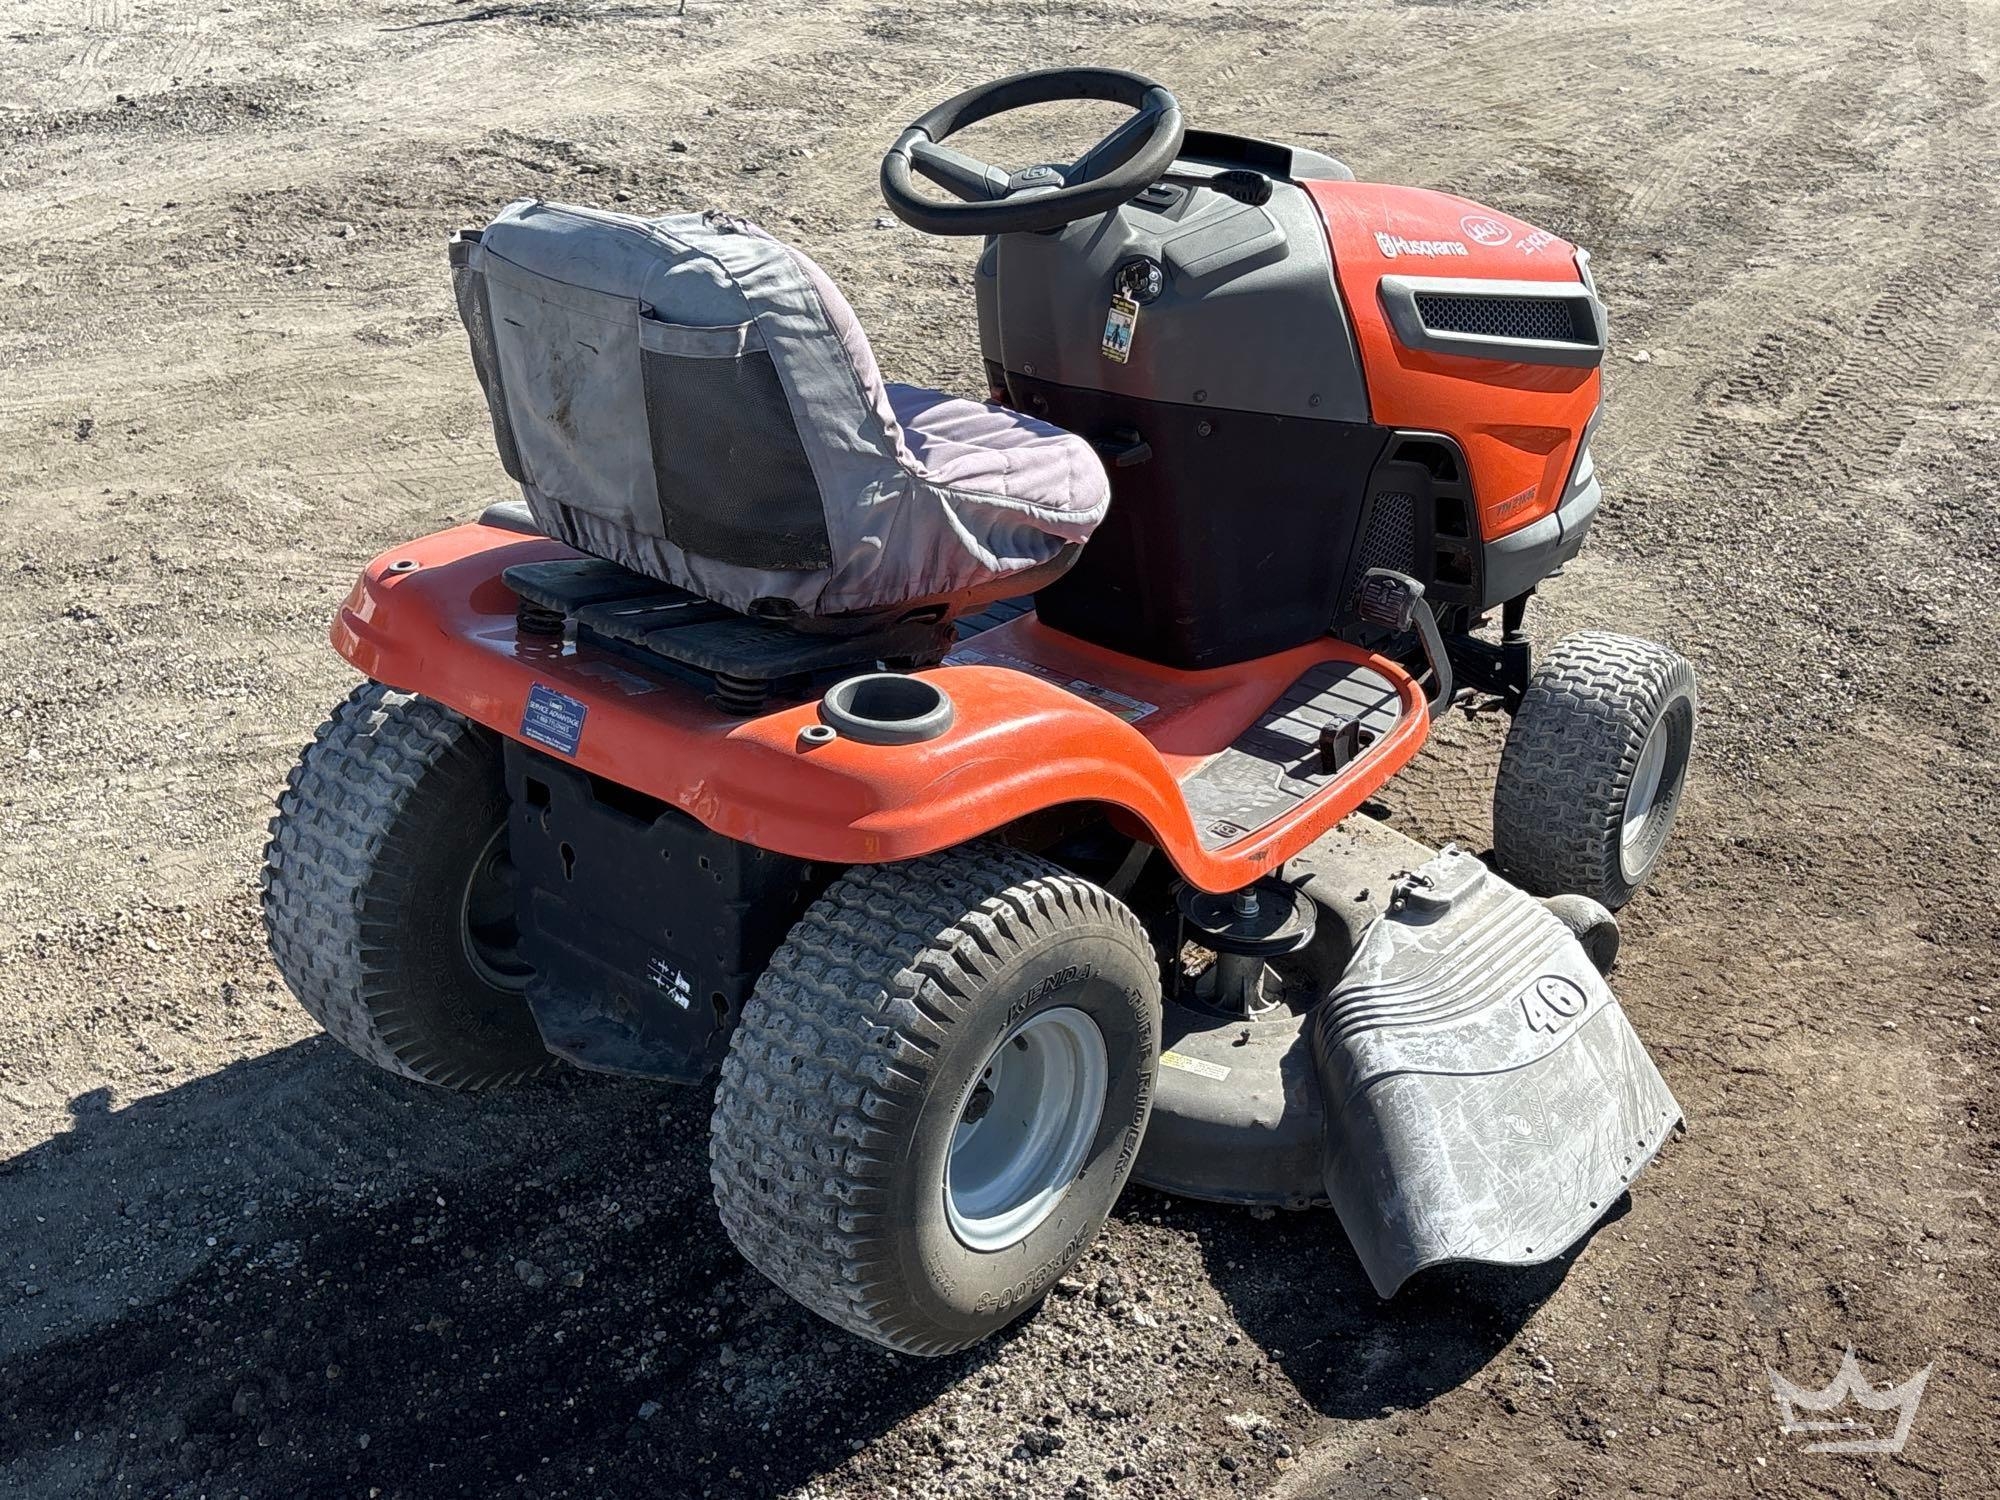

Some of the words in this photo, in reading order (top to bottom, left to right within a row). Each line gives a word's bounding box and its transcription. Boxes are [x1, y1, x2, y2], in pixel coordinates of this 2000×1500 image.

[1391, 235, 1469, 259] Husqvarna
[529, 700, 549, 715] SERVICE
[549, 709, 579, 727] ADVANTAGE
[1006, 961, 1092, 1023] KENDA
[1518, 974, 1588, 1035] 46
[1128, 988, 1153, 1061] TURF
[1114, 1068, 1152, 1177] RIDER
